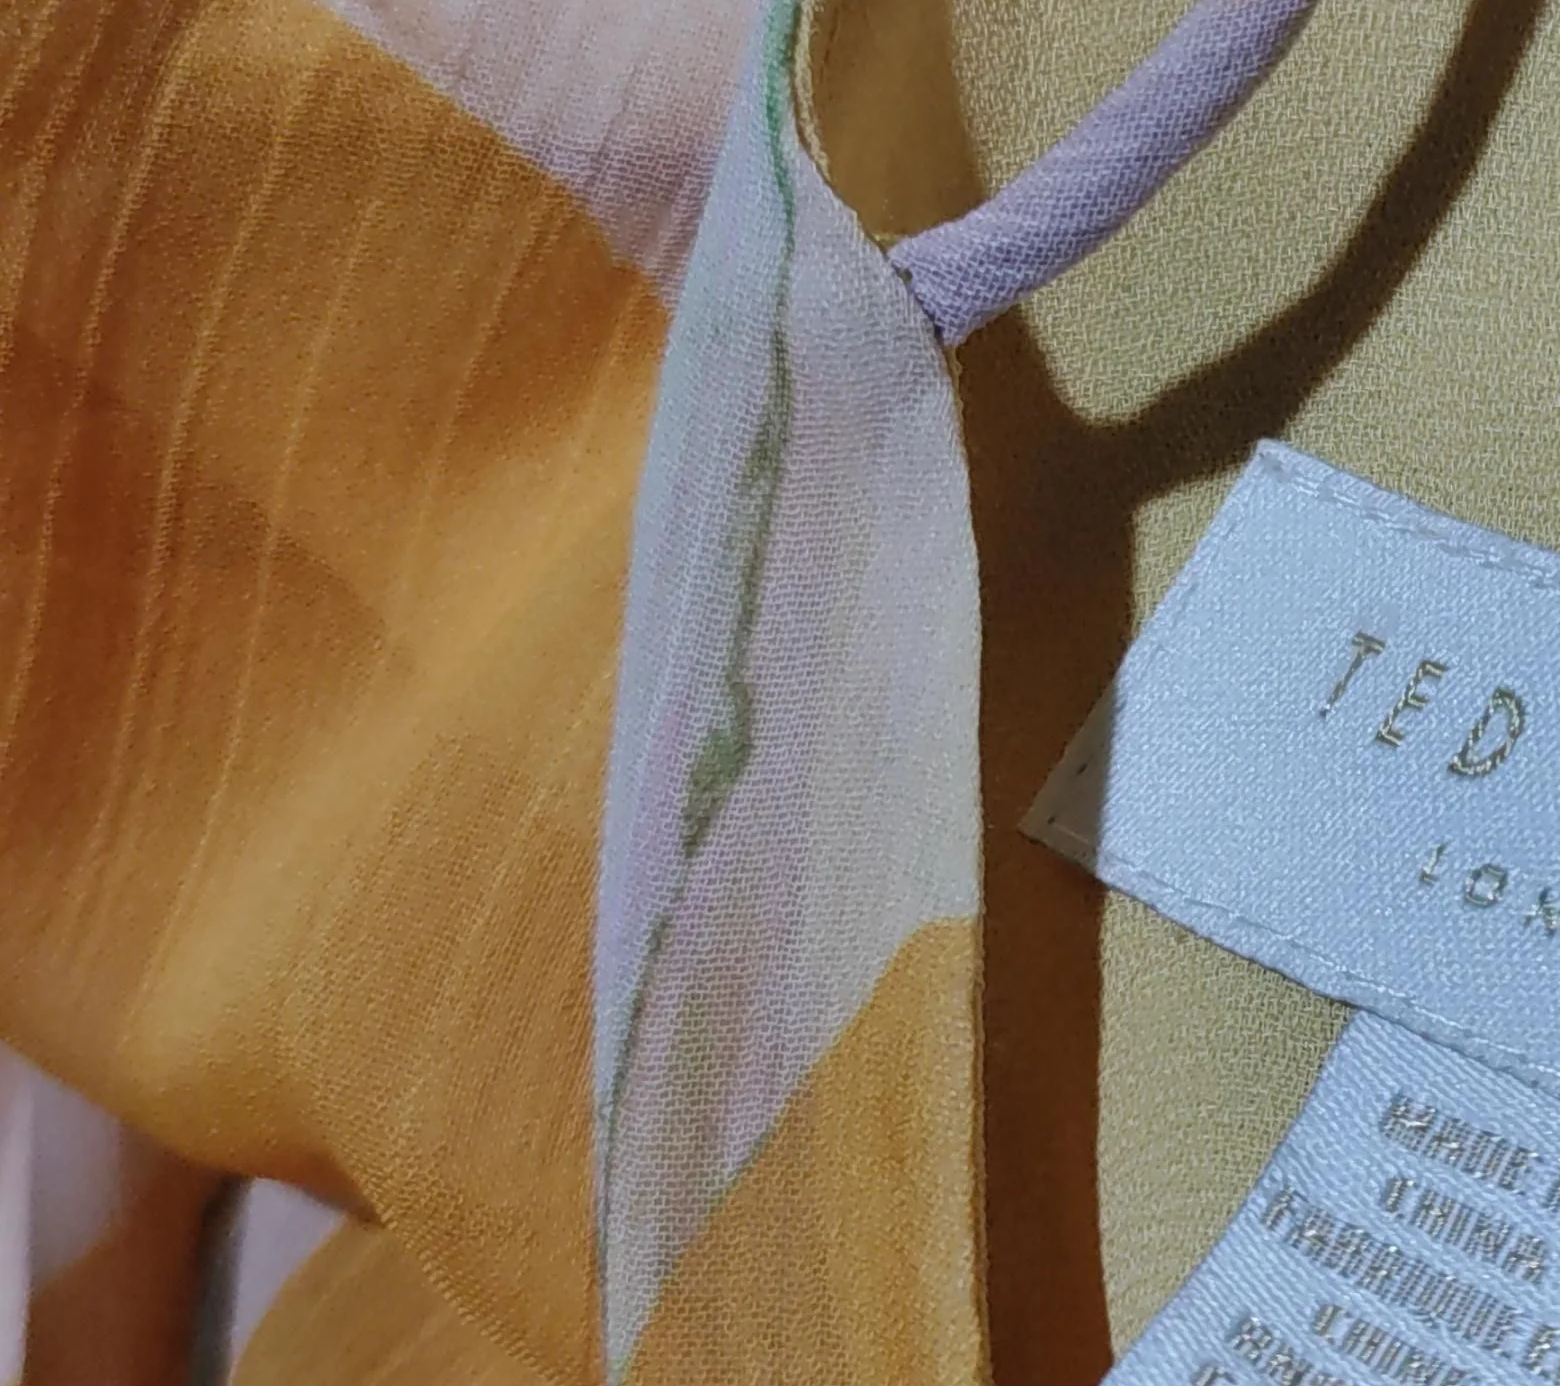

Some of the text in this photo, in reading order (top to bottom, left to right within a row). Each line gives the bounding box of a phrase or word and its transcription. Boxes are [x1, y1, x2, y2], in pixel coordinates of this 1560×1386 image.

[1318, 629, 1527, 777] TED
[1378, 1093, 1540, 1196] MADE
[1381, 1173, 1552, 1286] CHINA
